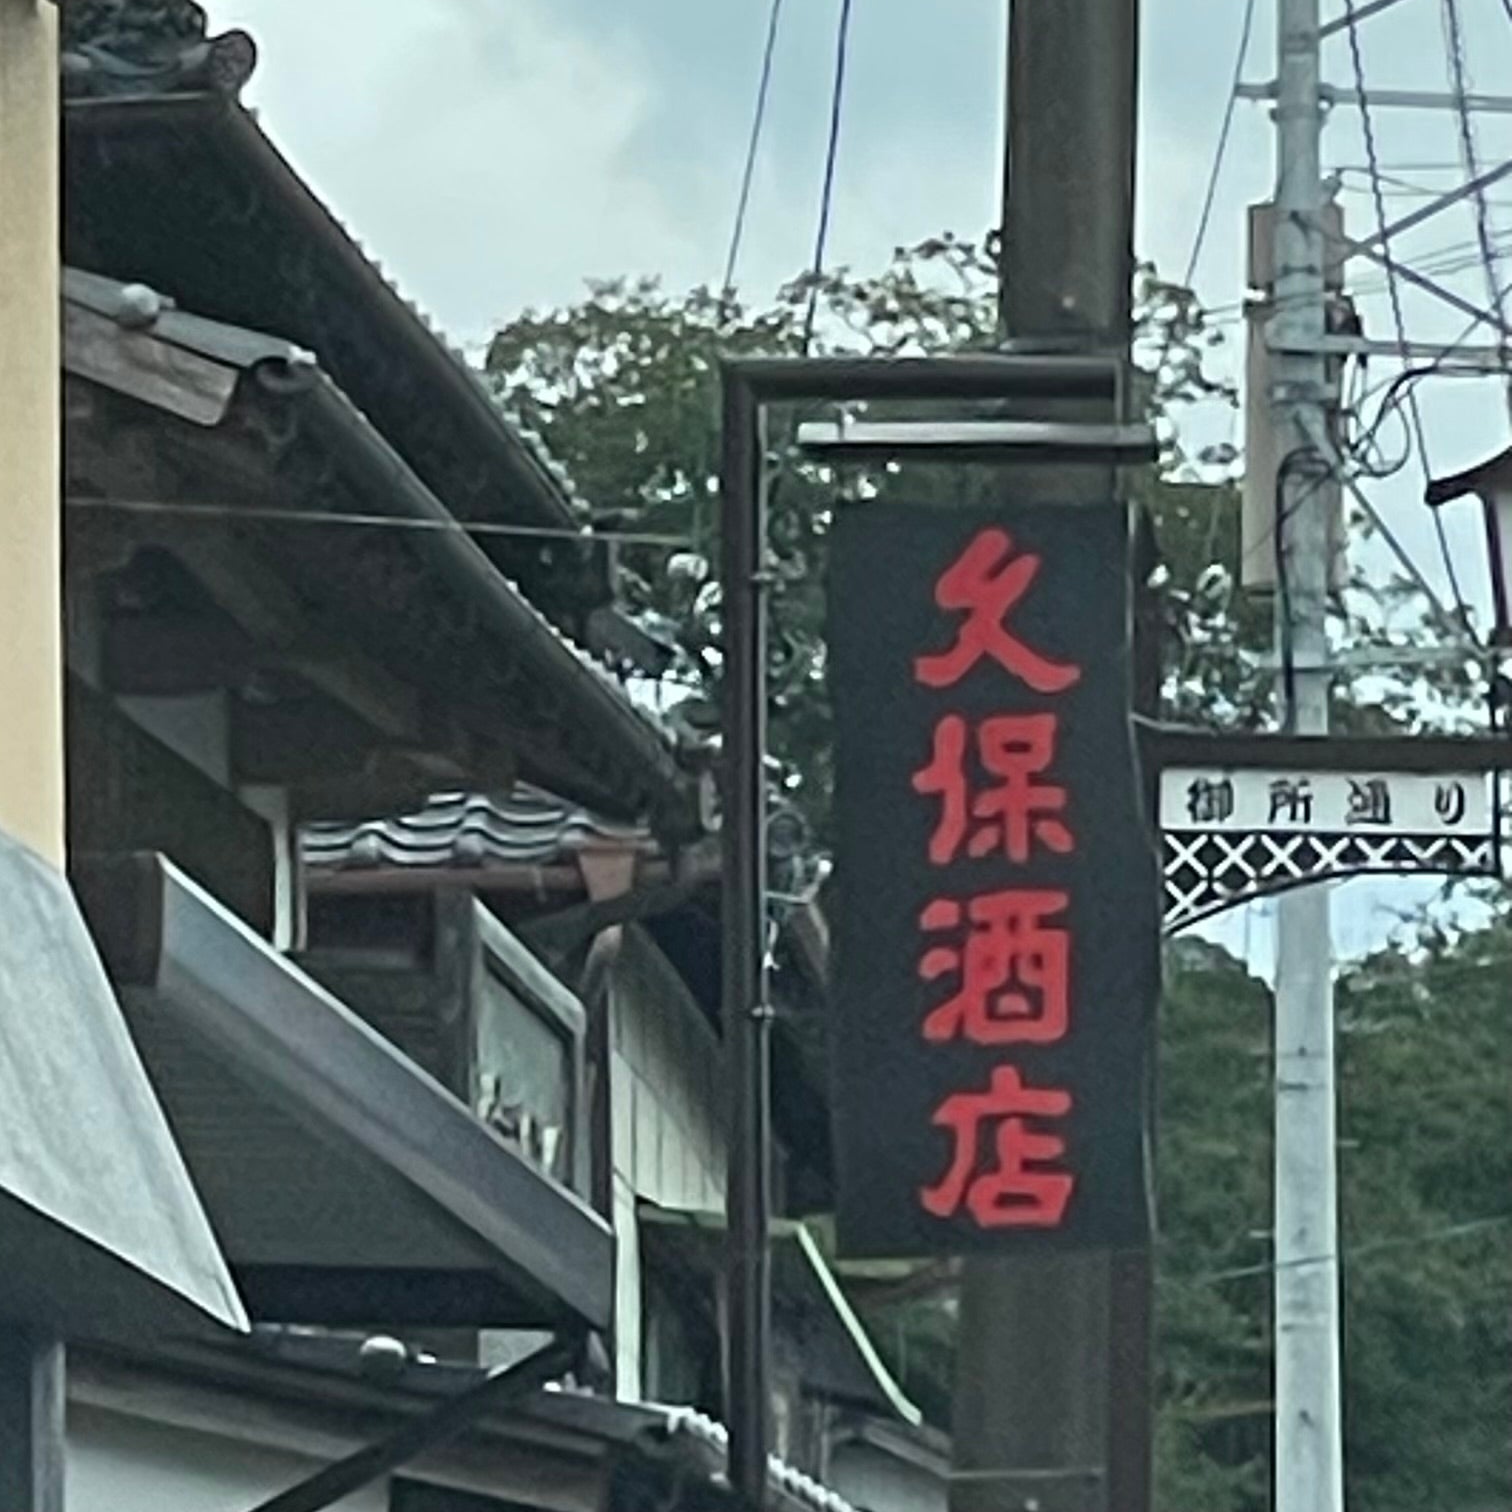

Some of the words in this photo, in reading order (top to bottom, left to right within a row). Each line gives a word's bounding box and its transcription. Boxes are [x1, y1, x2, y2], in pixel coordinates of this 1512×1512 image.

[912, 526, 1080, 1228] 久保酒店
[1186, 777, 1466, 825] 御所通り
